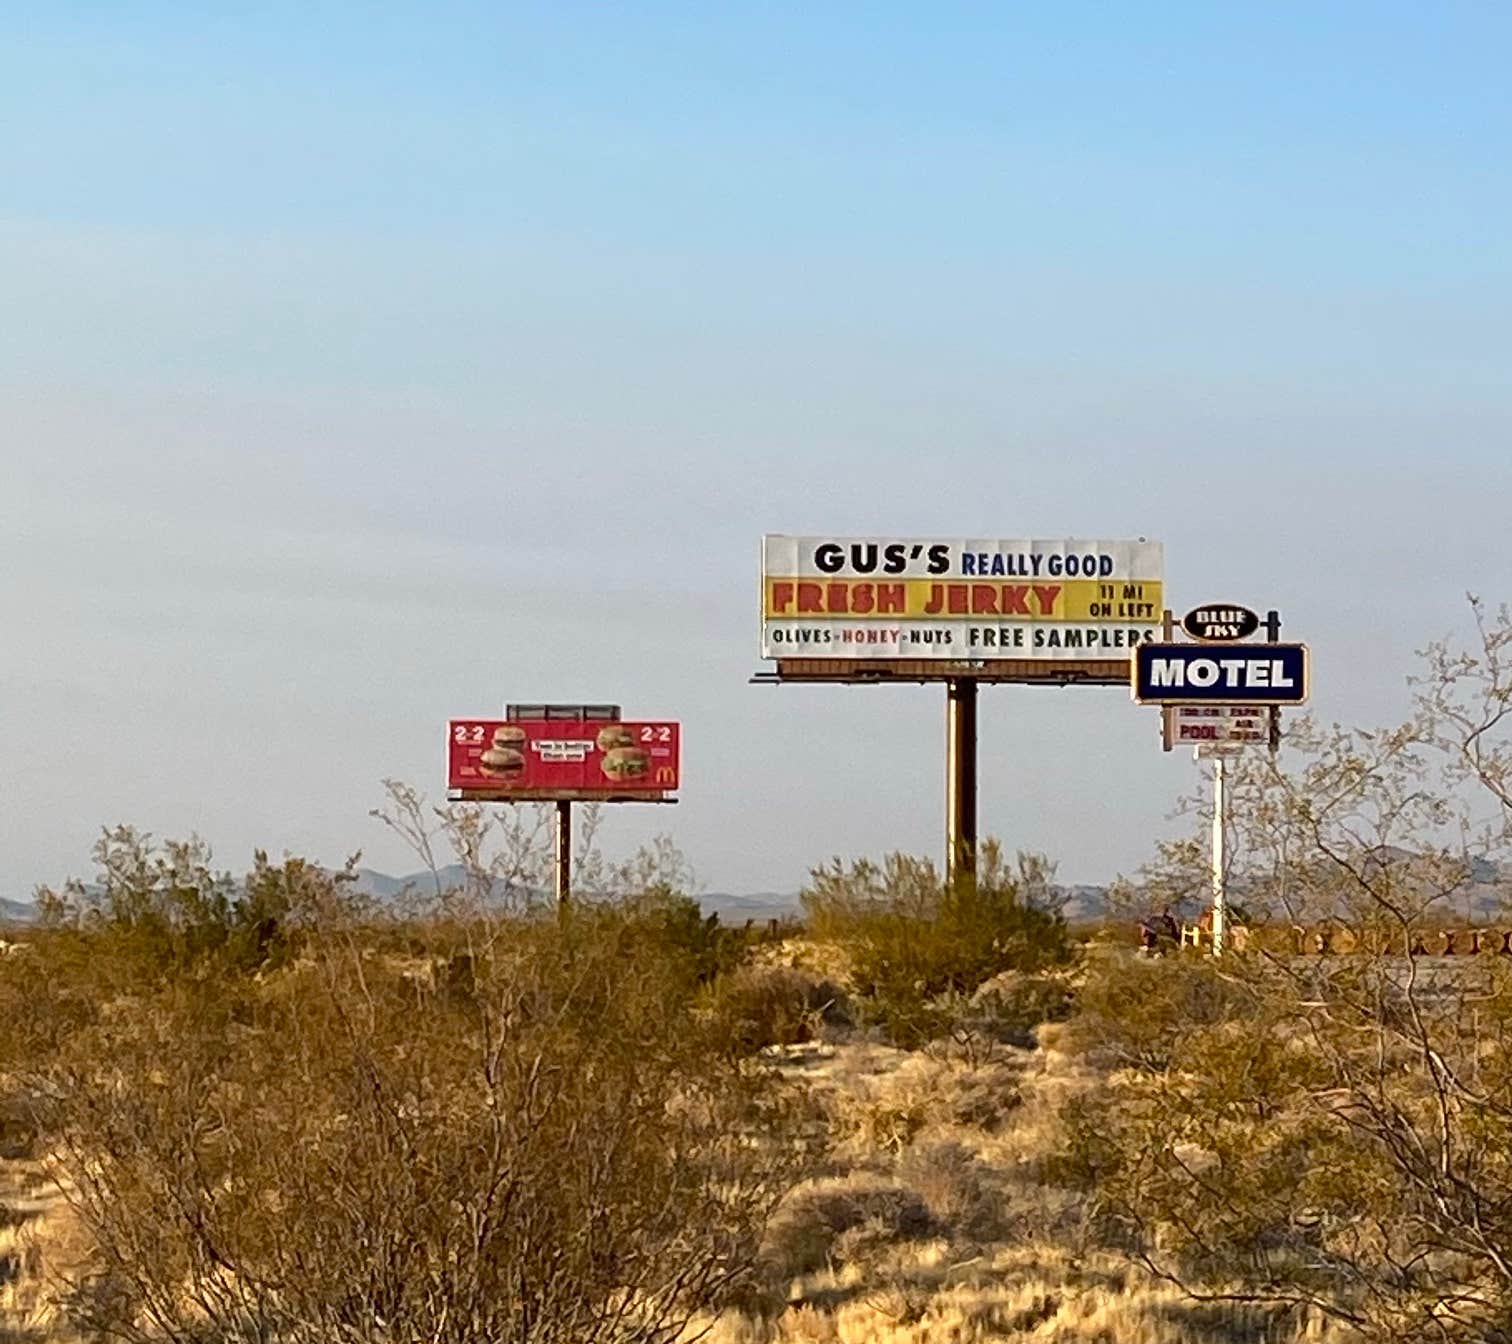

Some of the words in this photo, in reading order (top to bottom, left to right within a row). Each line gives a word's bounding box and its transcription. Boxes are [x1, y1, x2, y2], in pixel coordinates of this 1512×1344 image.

[814, 543, 950, 574] GUS'S
[962, 552, 1043, 576] REALLY
[1048, 554, 1113, 577] GOOD
[772, 582, 905, 614] FRESH
[924, 583, 1061, 615] JERKY
[1089, 603, 1112, 617] ON
[1118, 603, 1154, 618] LEFT
[1195, 610, 1247, 623] BLUE
[969, 627, 1024, 647] FREE
[1034, 628, 1154, 648] SAMPLERS
[1203, 624, 1241, 638] SKY
[1150, 658, 1294, 688] MOTEL
[1180, 724, 1220, 740] POOL
